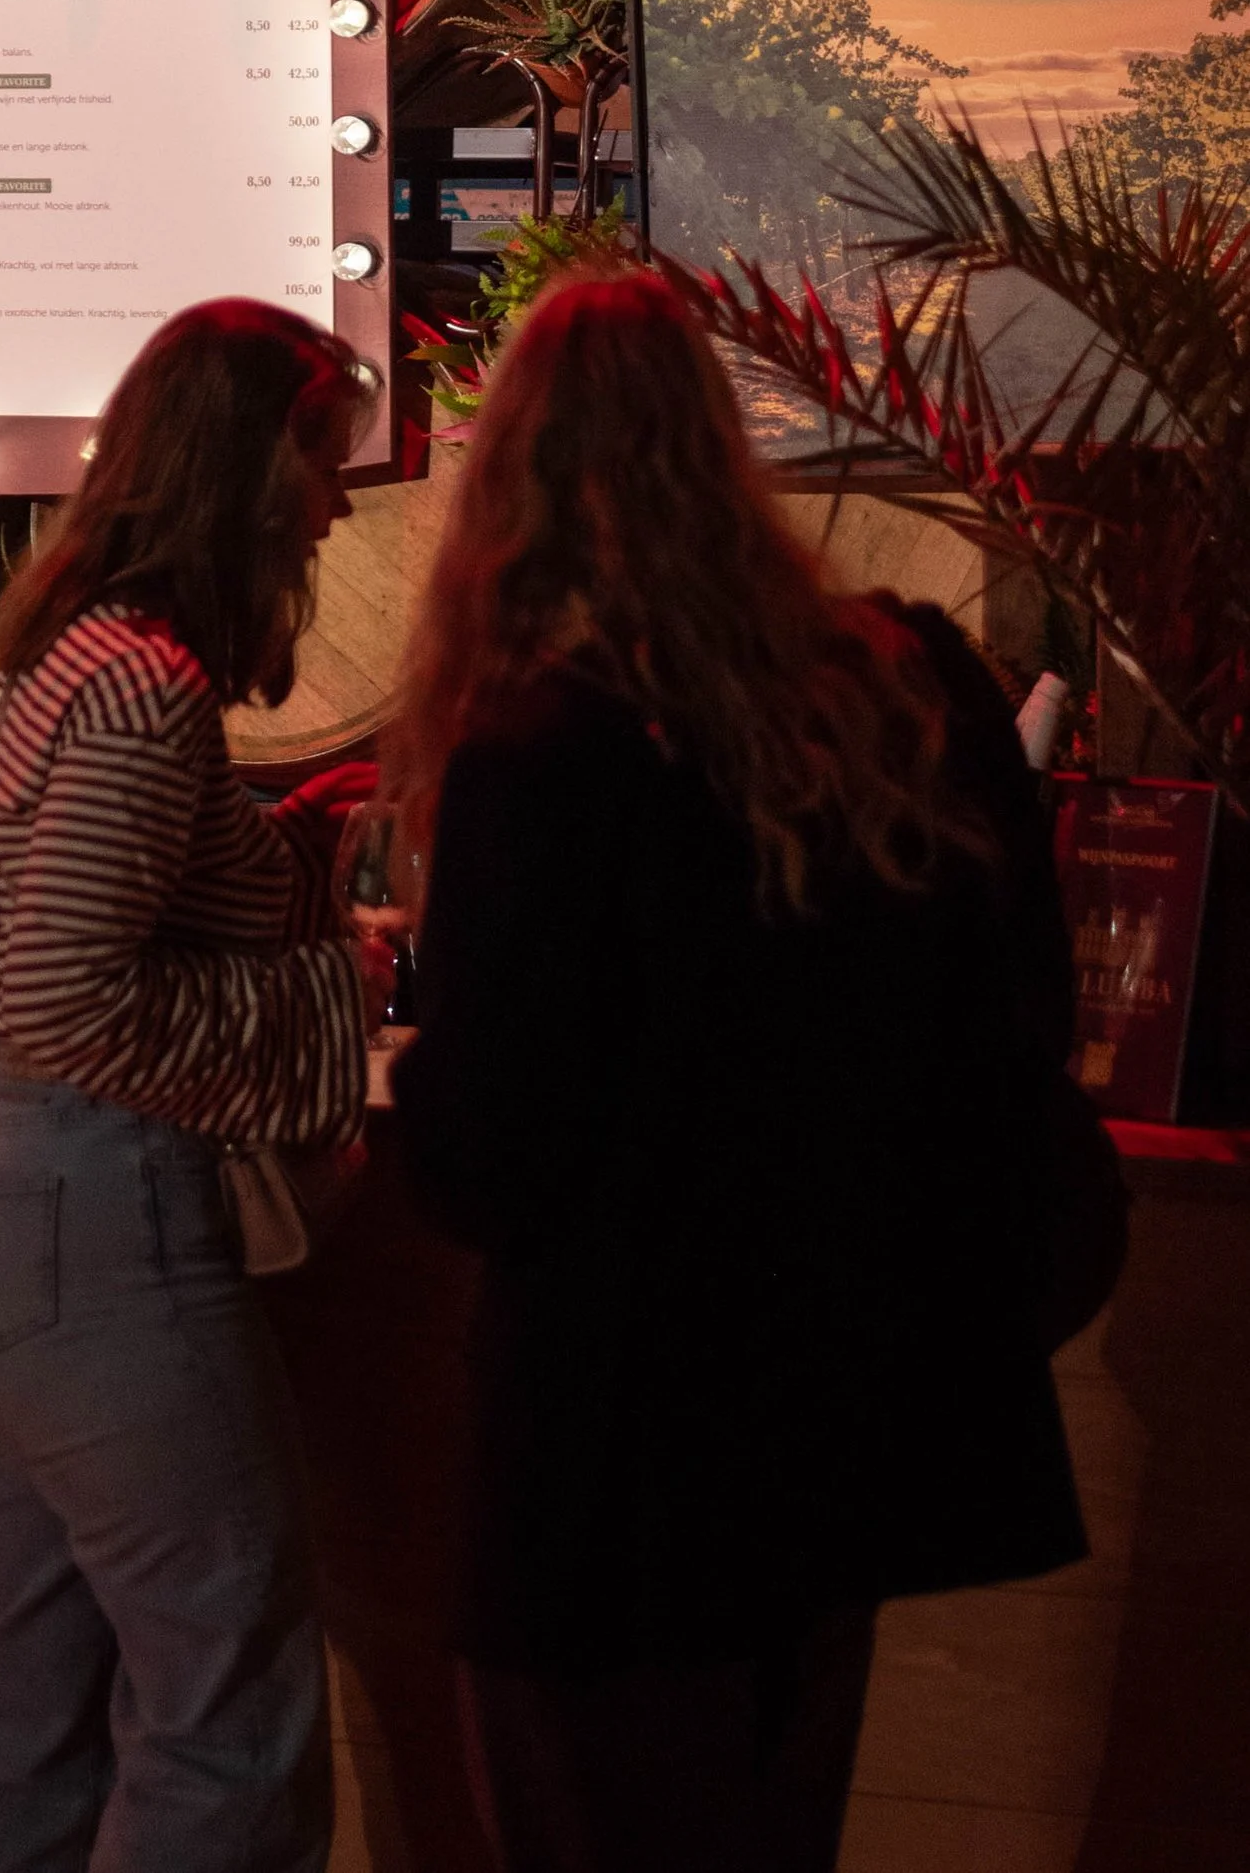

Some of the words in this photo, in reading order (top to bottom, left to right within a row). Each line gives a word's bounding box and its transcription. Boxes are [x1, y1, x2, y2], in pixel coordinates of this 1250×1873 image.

[246, 20, 270, 32] 8,50
[288, 20, 318, 32] 42,50
[246, 68, 271, 80] 8,50
[288, 68, 319, 79] 42,50
[0, 78, 46, 86] FAVORITE
[288, 116, 319, 128] 50,00
[0, 182, 46, 190] FAVORITE
[247, 176, 271, 188] 8,50
[288, 176, 319, 187] 42,50
[289, 236, 320, 248] 99,00
[286, 284, 322, 296] 105,00
